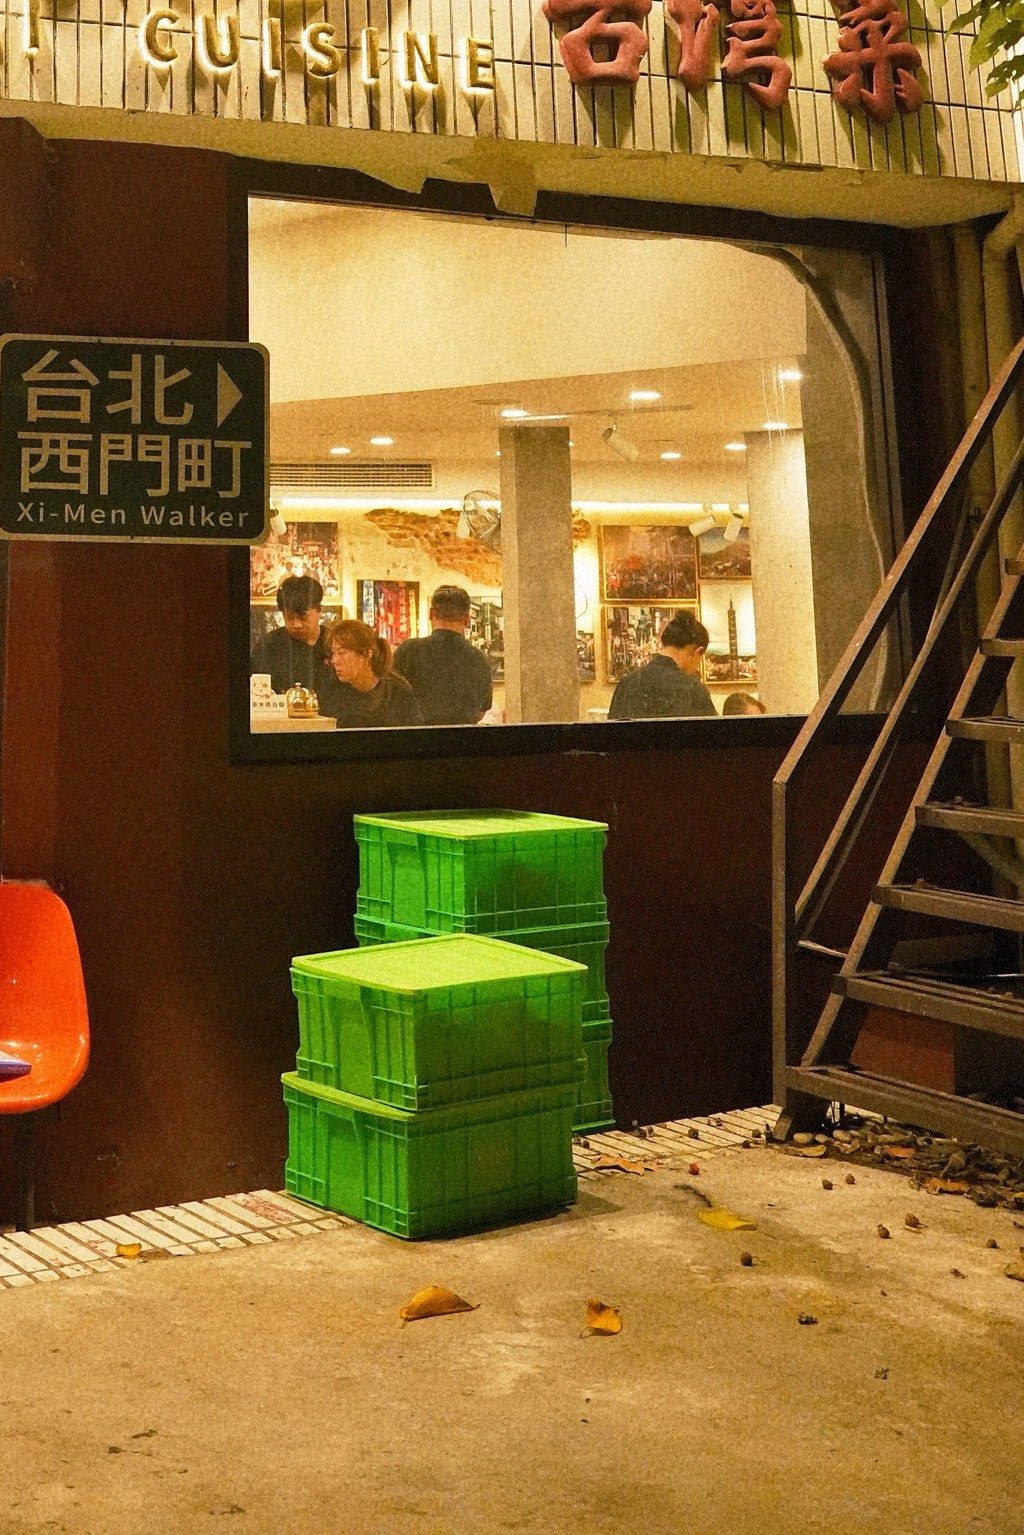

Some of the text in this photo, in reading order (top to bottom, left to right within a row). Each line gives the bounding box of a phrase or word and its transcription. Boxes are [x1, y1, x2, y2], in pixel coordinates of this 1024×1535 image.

[139, 5, 498, 92] CUISINE
[20, 348, 194, 426] 台北
[16, 430, 253, 499] 西門町
[16, 501, 250, 528] Xi-Men Walker
